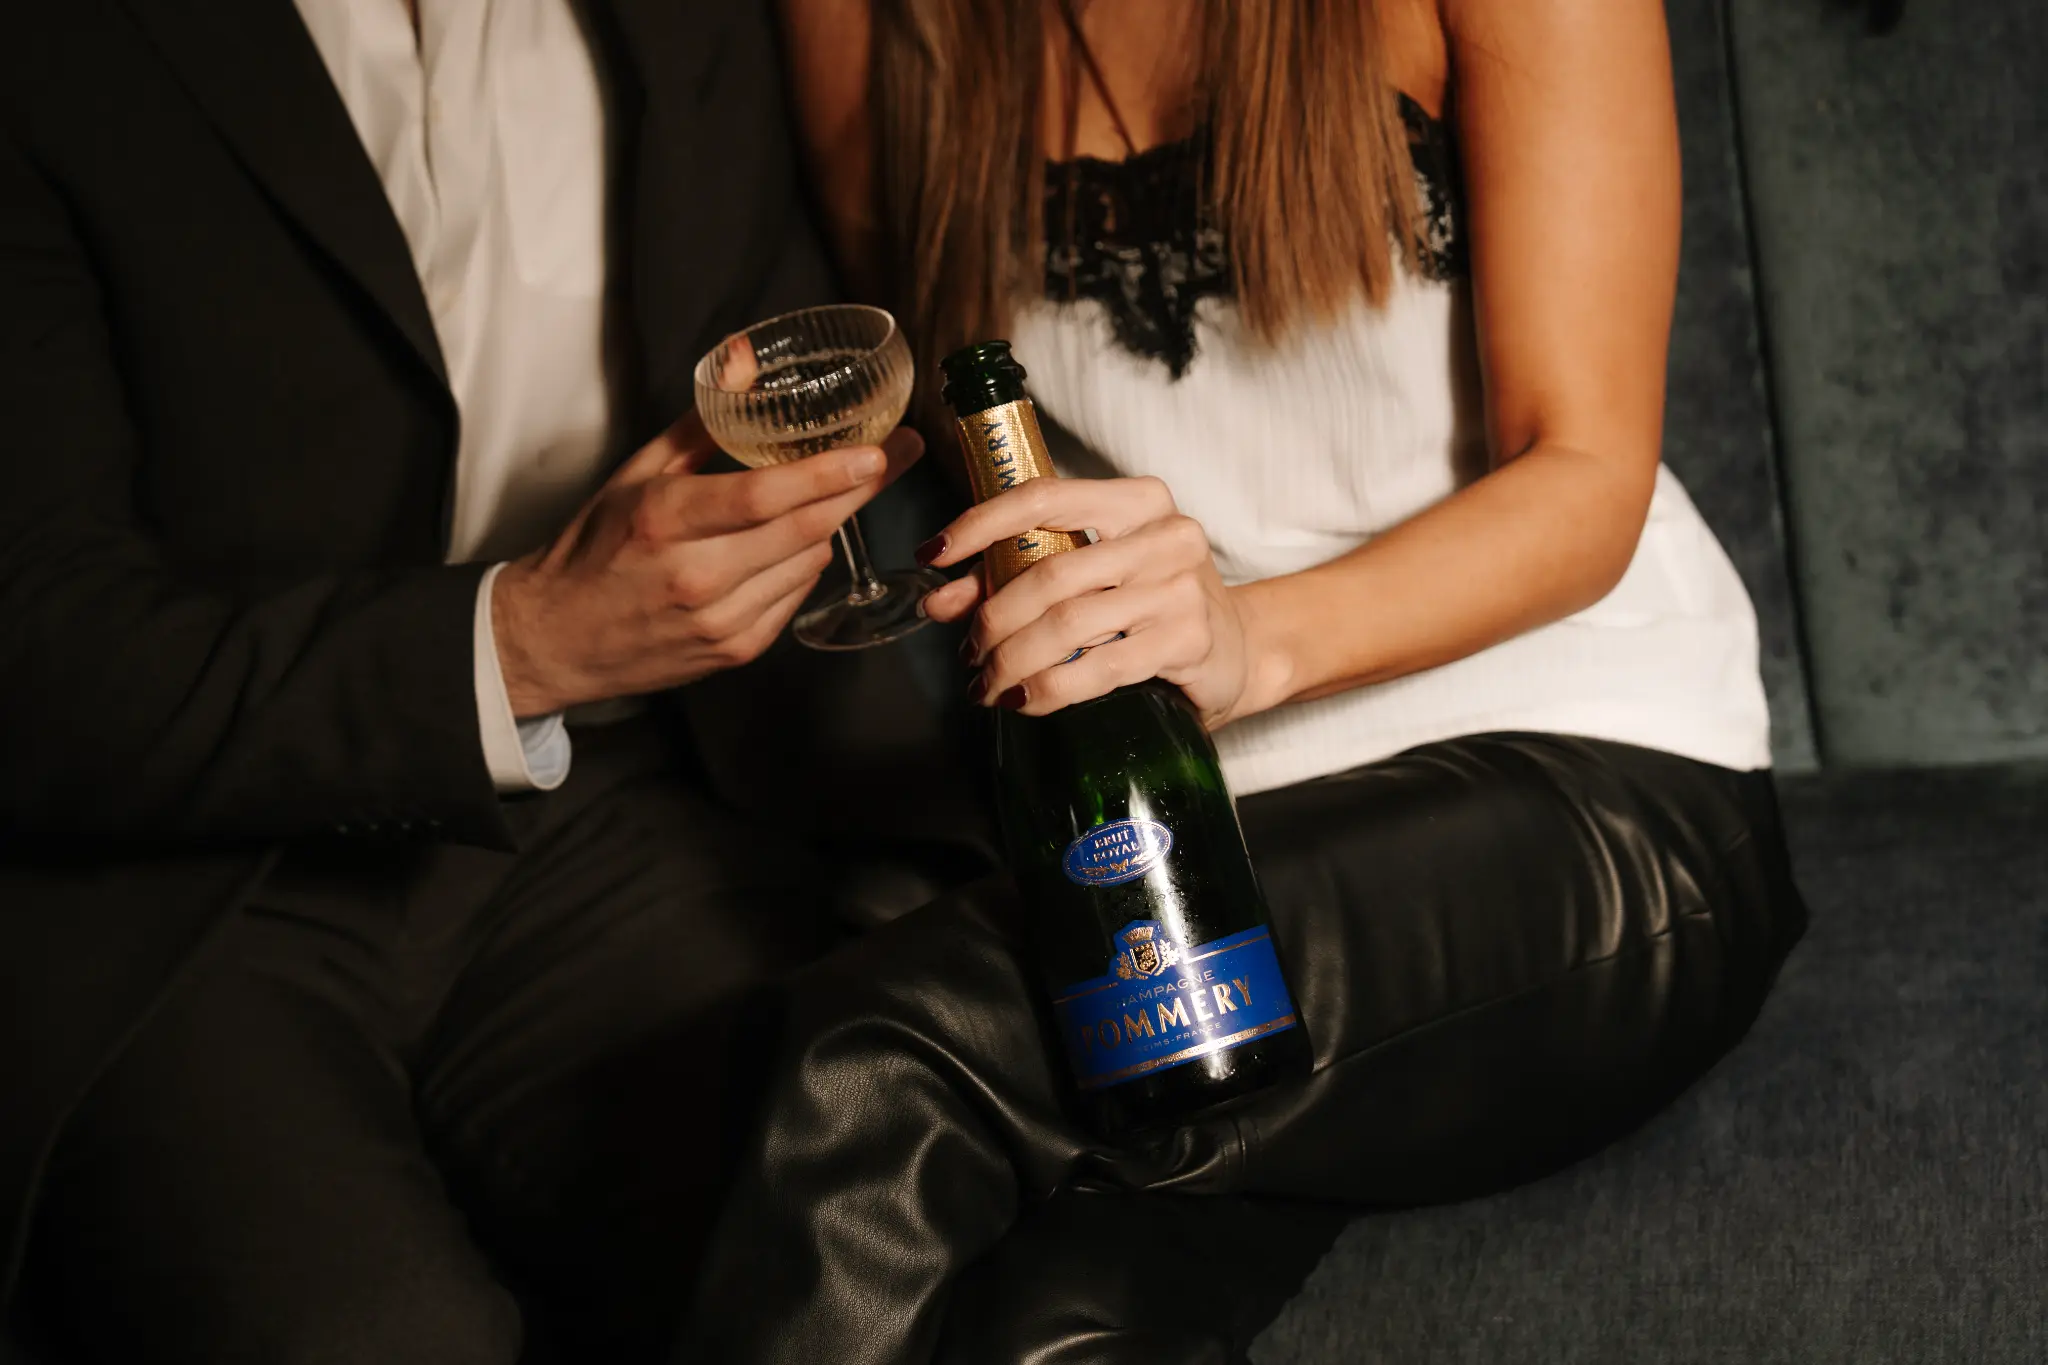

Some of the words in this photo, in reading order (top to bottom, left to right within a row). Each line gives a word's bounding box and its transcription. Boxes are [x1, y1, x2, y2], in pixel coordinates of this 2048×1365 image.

[1094, 829, 1130, 849] BRUT
[1093, 841, 1140, 862] ROYAL
[1081, 975, 1253, 1054] POMMERY
